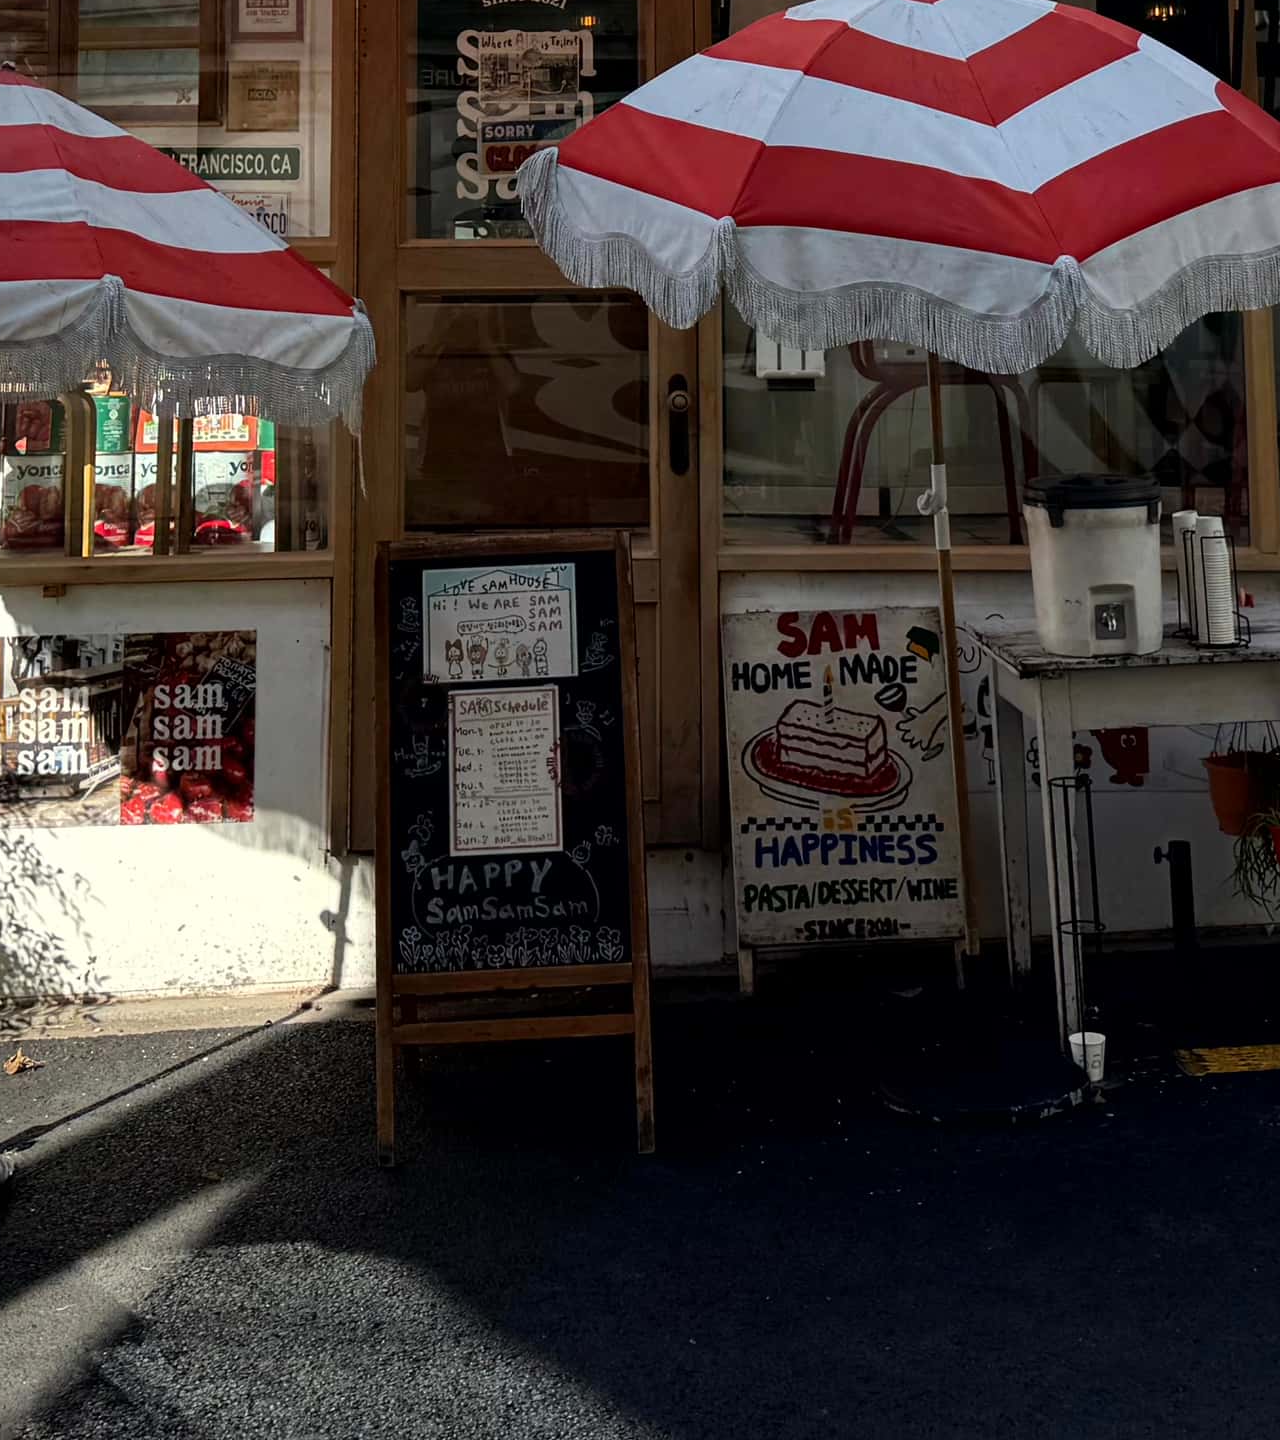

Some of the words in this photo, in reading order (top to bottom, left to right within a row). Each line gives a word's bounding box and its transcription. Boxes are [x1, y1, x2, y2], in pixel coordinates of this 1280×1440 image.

[484, 124, 535, 138] SORRY
[271, 153, 292, 174] CA
[444, 580, 475, 596] LOVE
[509, 573, 551, 589] HOUSE
[494, 596, 521, 609] ARE
[529, 594, 560, 607] SAM
[528, 606, 562, 619] SAM
[528, 620, 563, 632] SAM
[777, 611, 881, 657] SAM
[732, 661, 812, 693] HOME
[840, 654, 918, 685] MADE
[20, 687, 90, 713] sam
[154, 682, 225, 710] sam
[17, 716, 90, 745] sam
[153, 714, 224, 741] sam
[16, 746, 90, 776] sam
[152, 745, 223, 772] sam
[754, 833, 938, 868] HAPPINESS
[430, 857, 553, 895] HAPPY
